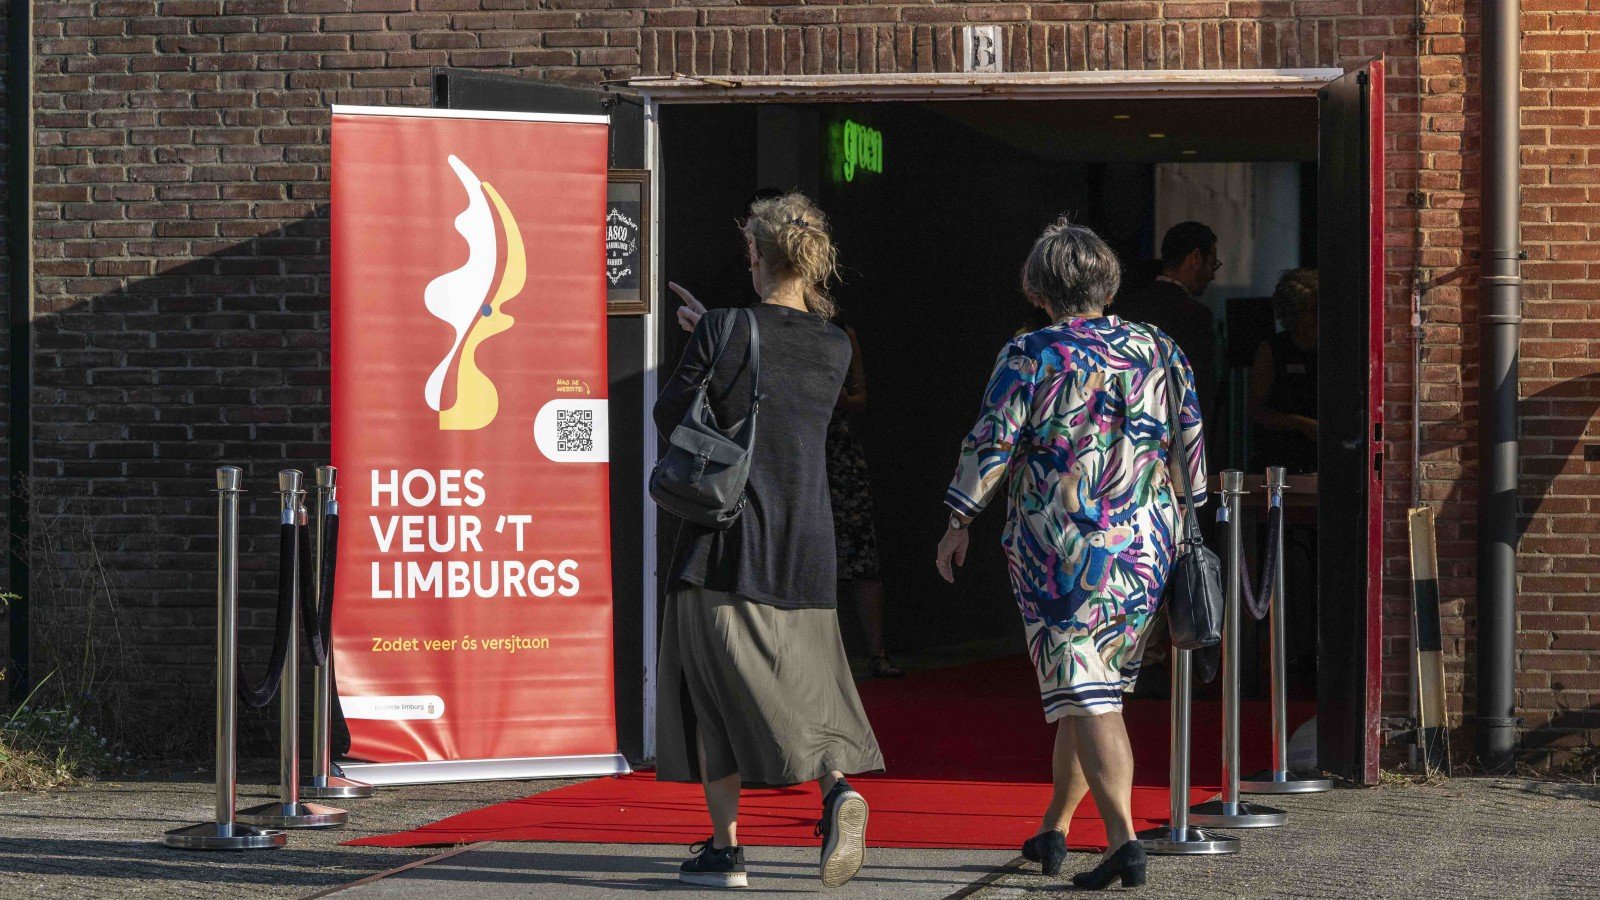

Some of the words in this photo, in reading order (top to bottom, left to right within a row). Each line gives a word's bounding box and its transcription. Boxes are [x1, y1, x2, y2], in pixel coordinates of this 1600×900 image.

[843, 119, 883, 182] groen
[371, 468, 486, 507] HOES
[369, 515, 484, 553] VEUR
[371, 559, 581, 599] LIMBURGS
[372, 637, 419, 652] Zodet
[423, 638, 458, 651] veer
[461, 635, 478, 650] ós
[481, 634, 550, 653] versjtaon
[401, 703, 424, 711] limburg
